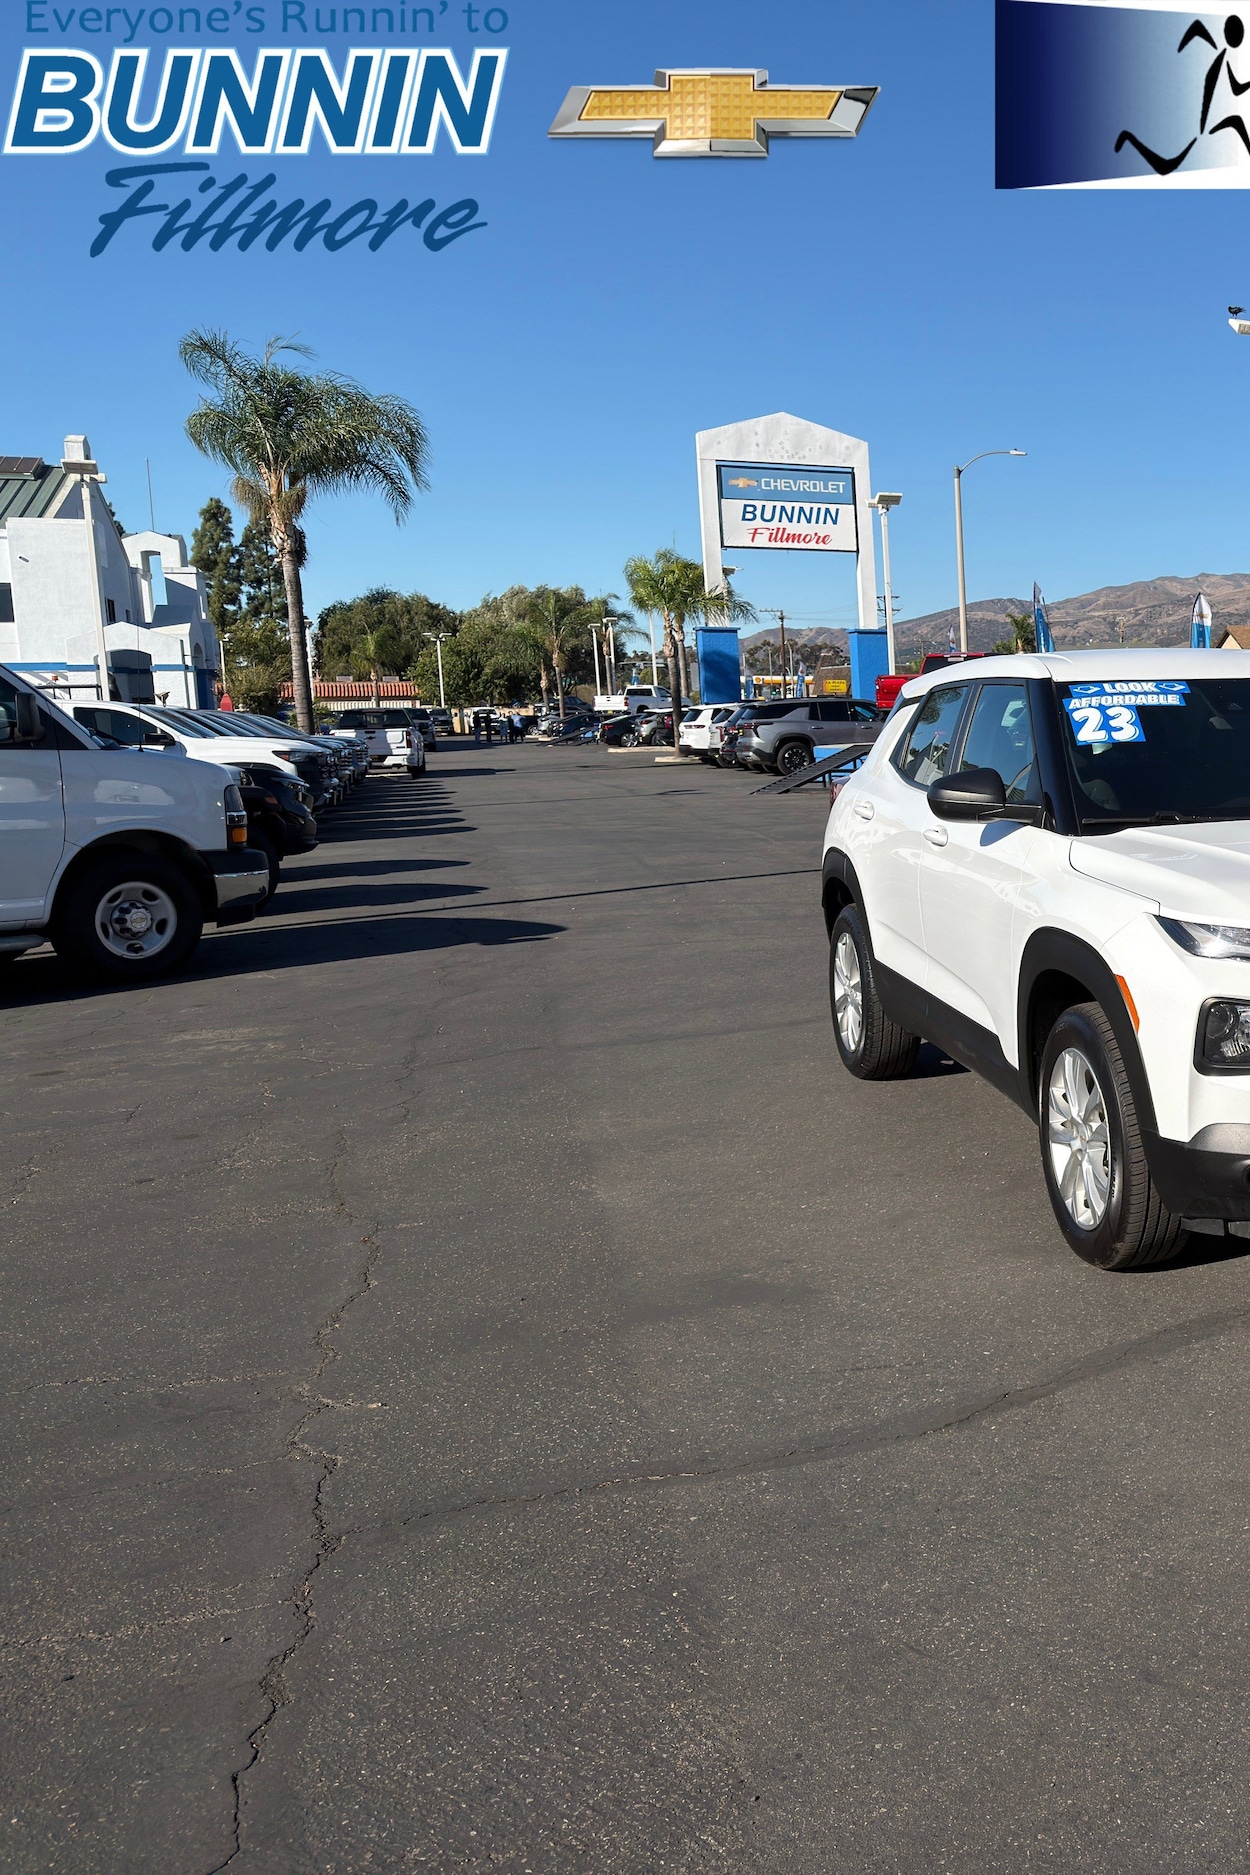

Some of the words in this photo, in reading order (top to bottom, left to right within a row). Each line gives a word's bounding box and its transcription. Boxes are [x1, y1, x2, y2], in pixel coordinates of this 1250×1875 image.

[761, 478, 845, 493] CHEVROLET
[741, 503, 840, 525] BUNNIN
[747, 527, 832, 545] Fillmore
[1102, 682, 1160, 693] LOOK
[1068, 693, 1180, 710] AFFORDABLE
[1071, 706, 1140, 742] 23
